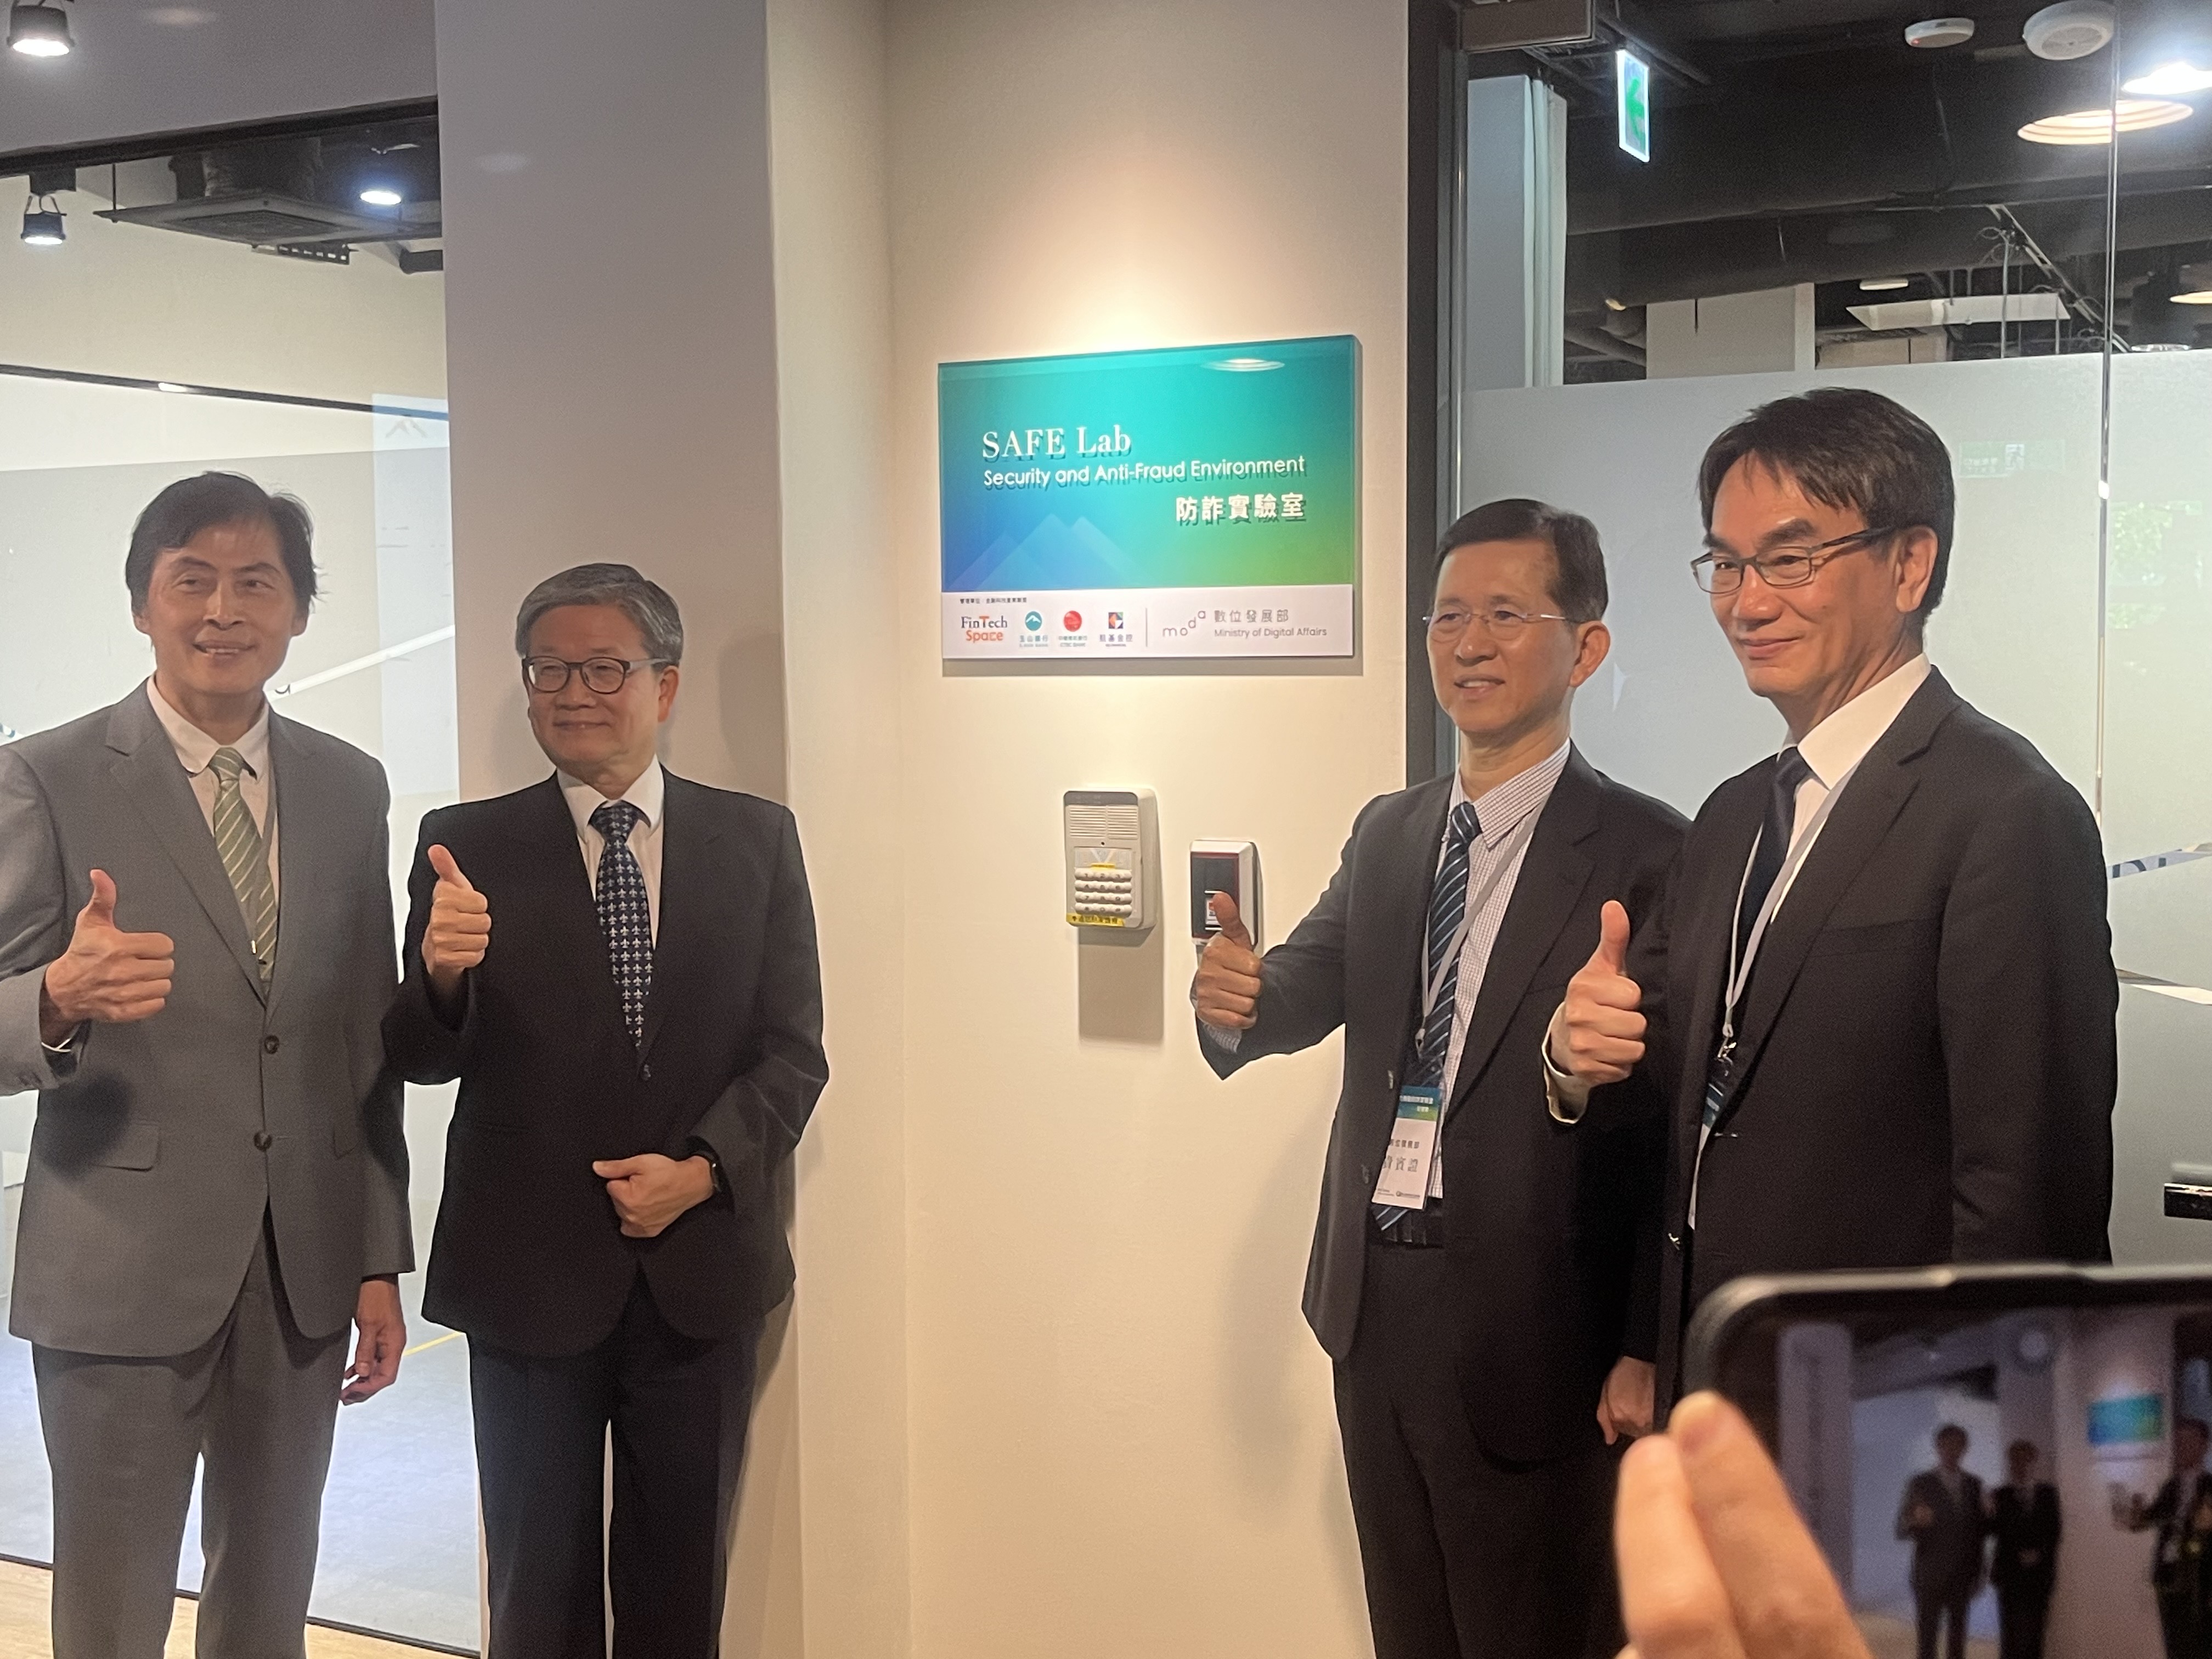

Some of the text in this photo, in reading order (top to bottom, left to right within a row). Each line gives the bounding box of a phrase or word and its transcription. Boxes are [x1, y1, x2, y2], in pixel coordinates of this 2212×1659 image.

[983, 424, 1132, 458] SAFE Lab
[984, 455, 1305, 487] Security and Anti-Fraud Environment
[1176, 492, 1304, 522] 防詐實驗室
[961, 615, 1008, 628] FinTech
[1214, 609, 1289, 623] 數位發展部
[966, 630, 1003, 643] Space
[1214, 627, 1327, 639] Ministry of Digital Affairs
